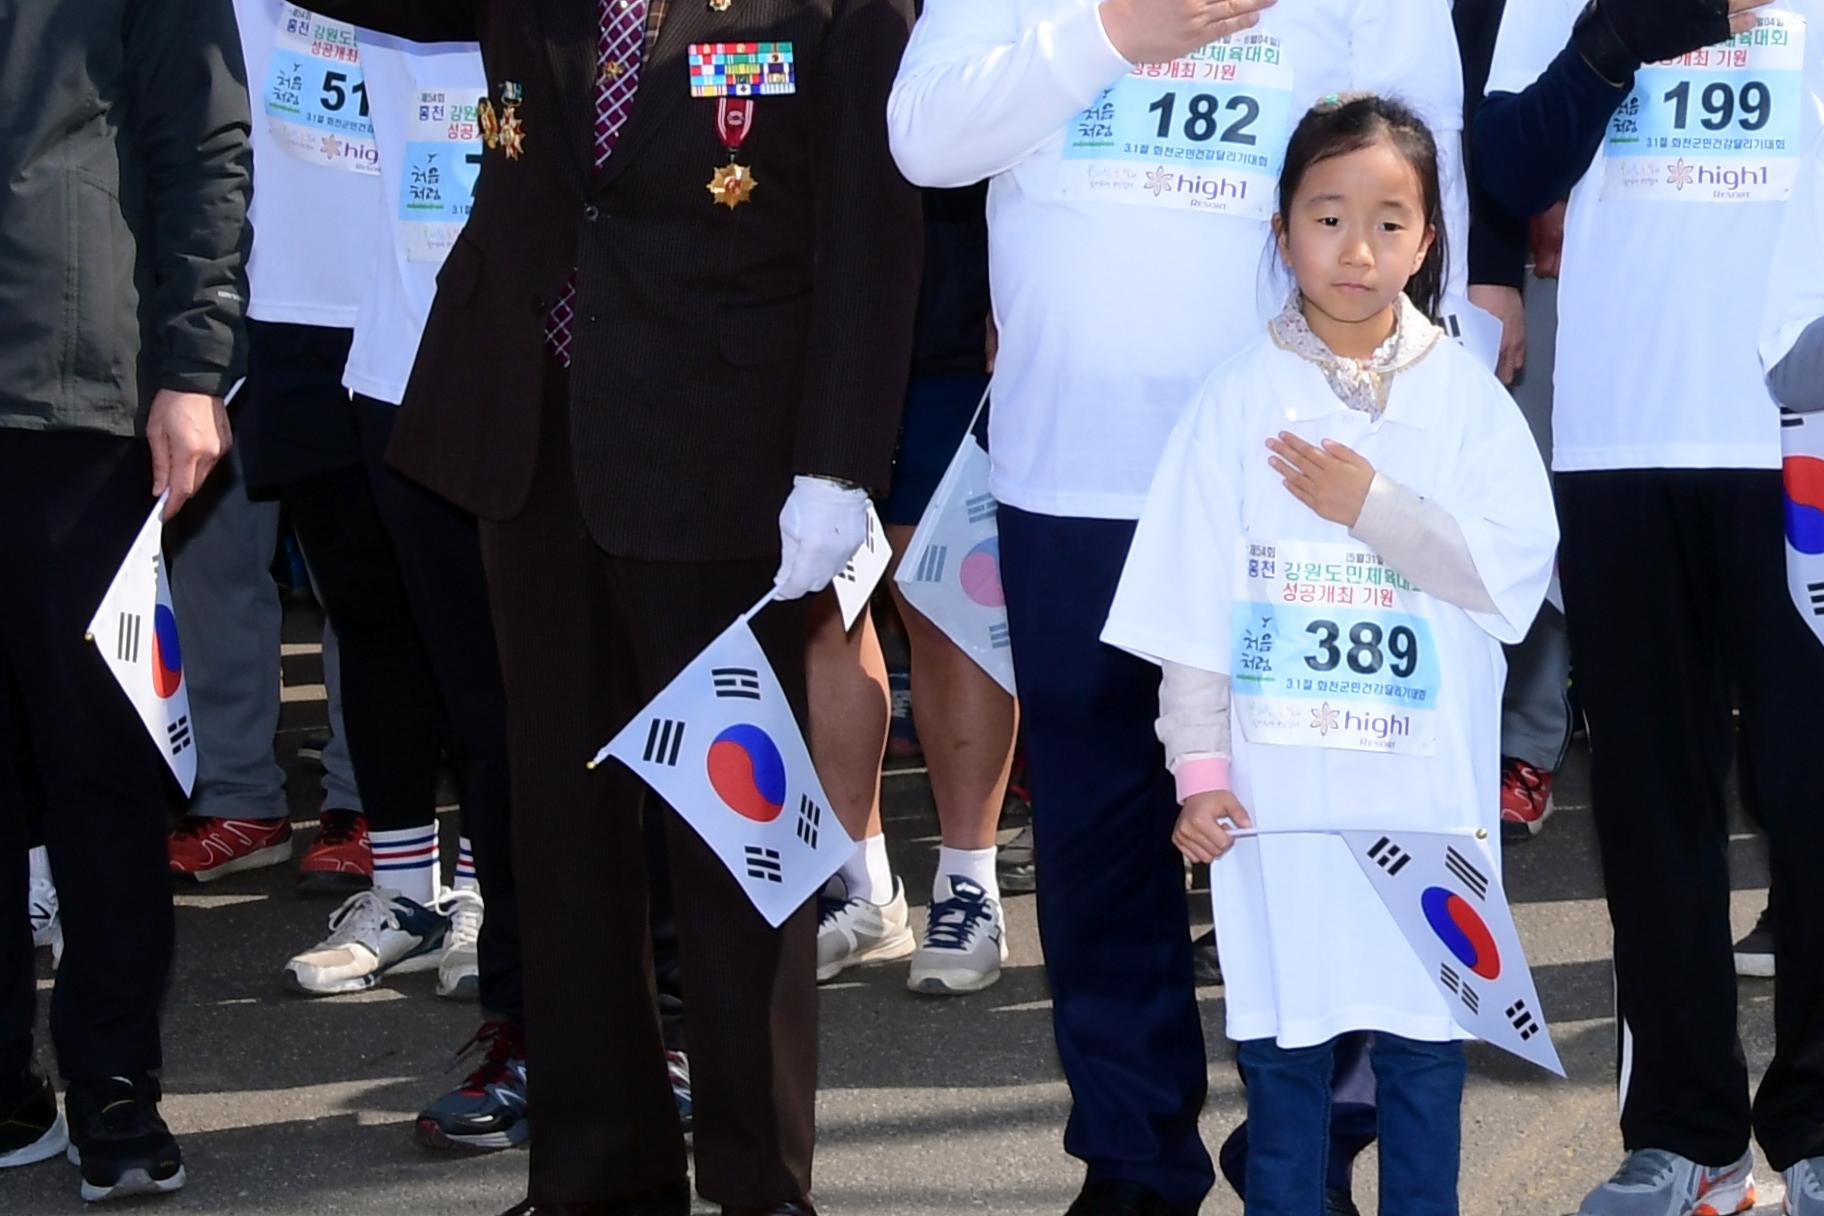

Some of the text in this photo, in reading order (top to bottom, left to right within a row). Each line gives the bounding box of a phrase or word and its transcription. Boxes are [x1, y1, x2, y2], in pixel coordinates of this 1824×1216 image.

[314, 24, 357, 48] 강원도
[311, 40, 358, 63] 성공개최
[1716, 48, 1748, 67] 기원
[1204, 63, 1236, 81] 기원
[419, 105, 444, 121] 홍천
[1663, 80, 1772, 131] 199
[1148, 91, 1260, 146] 182
[448, 124, 481, 140] 성공
[1671, 137, 1785, 150] 화천군민건강달리기대회
[1153, 145, 1268, 167] 화천군민건강달리기대회
[1177, 174, 1247, 200] high1
[1698, 165, 1768, 190] high1
[1248, 559, 1275, 579] 홍천
[1282, 583, 1394, 608] 성공개최 기원
[1303, 619, 1418, 678] 389
